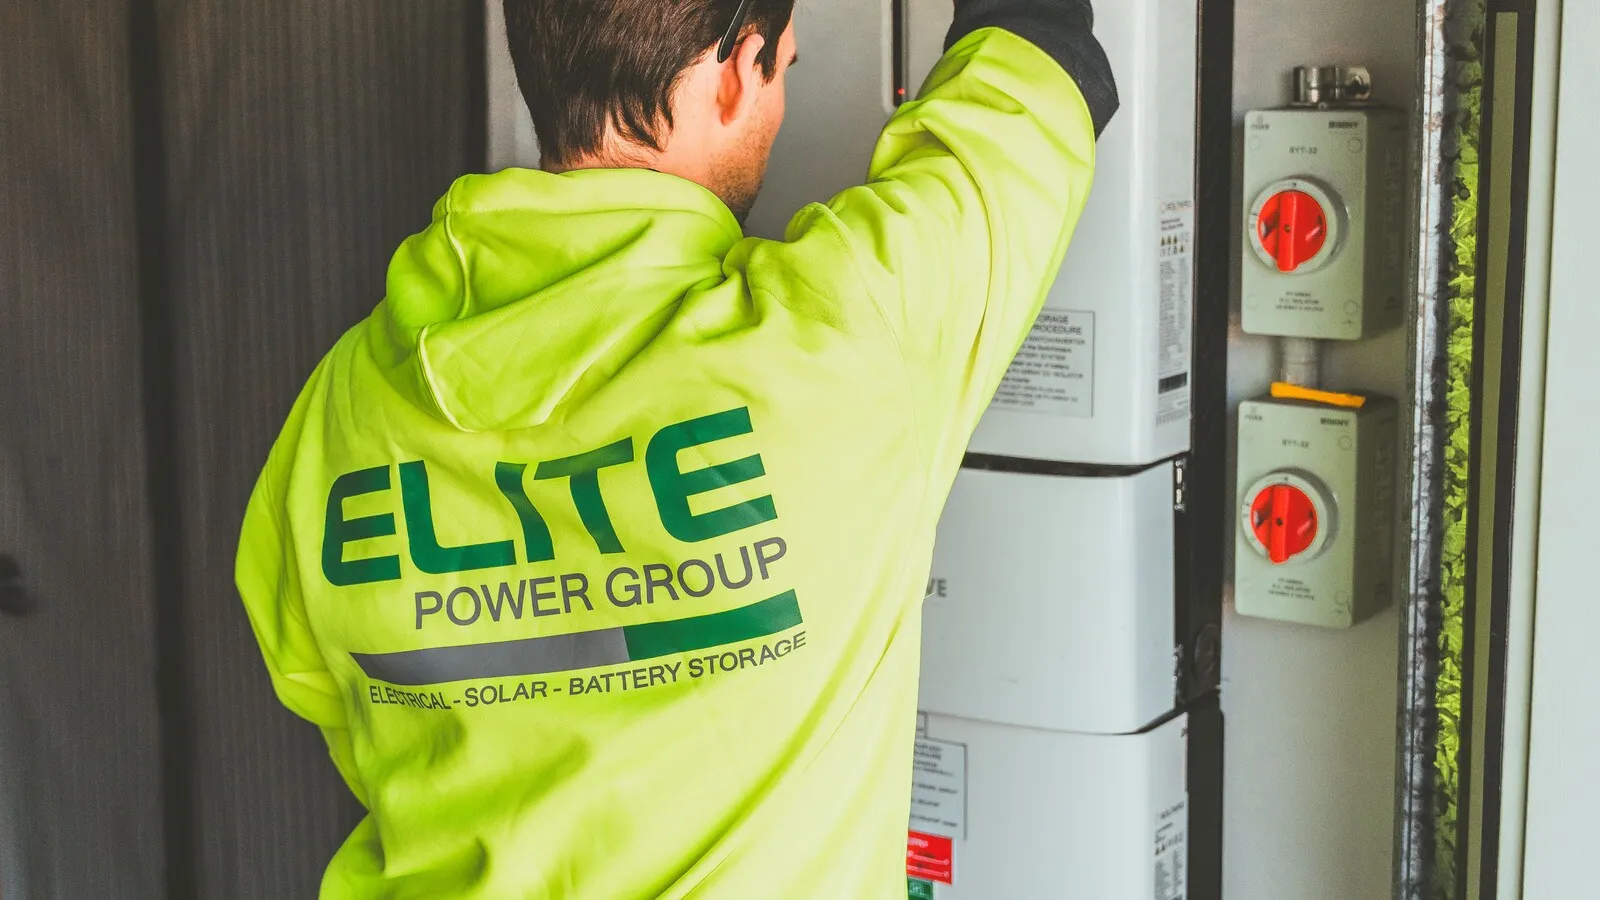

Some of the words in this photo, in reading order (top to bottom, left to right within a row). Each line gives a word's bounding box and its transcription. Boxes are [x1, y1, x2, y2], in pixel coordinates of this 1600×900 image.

[321, 406, 778, 586] ELITE
[414, 573, 593, 629] POWER
[605, 536, 788, 606] GROUP
[369, 685, 451, 709] ELECTRICAL
[465, 681, 548, 708] SOLAR
[569, 661, 682, 696] BATTERY
[688, 631, 807, 678] STORAGE
